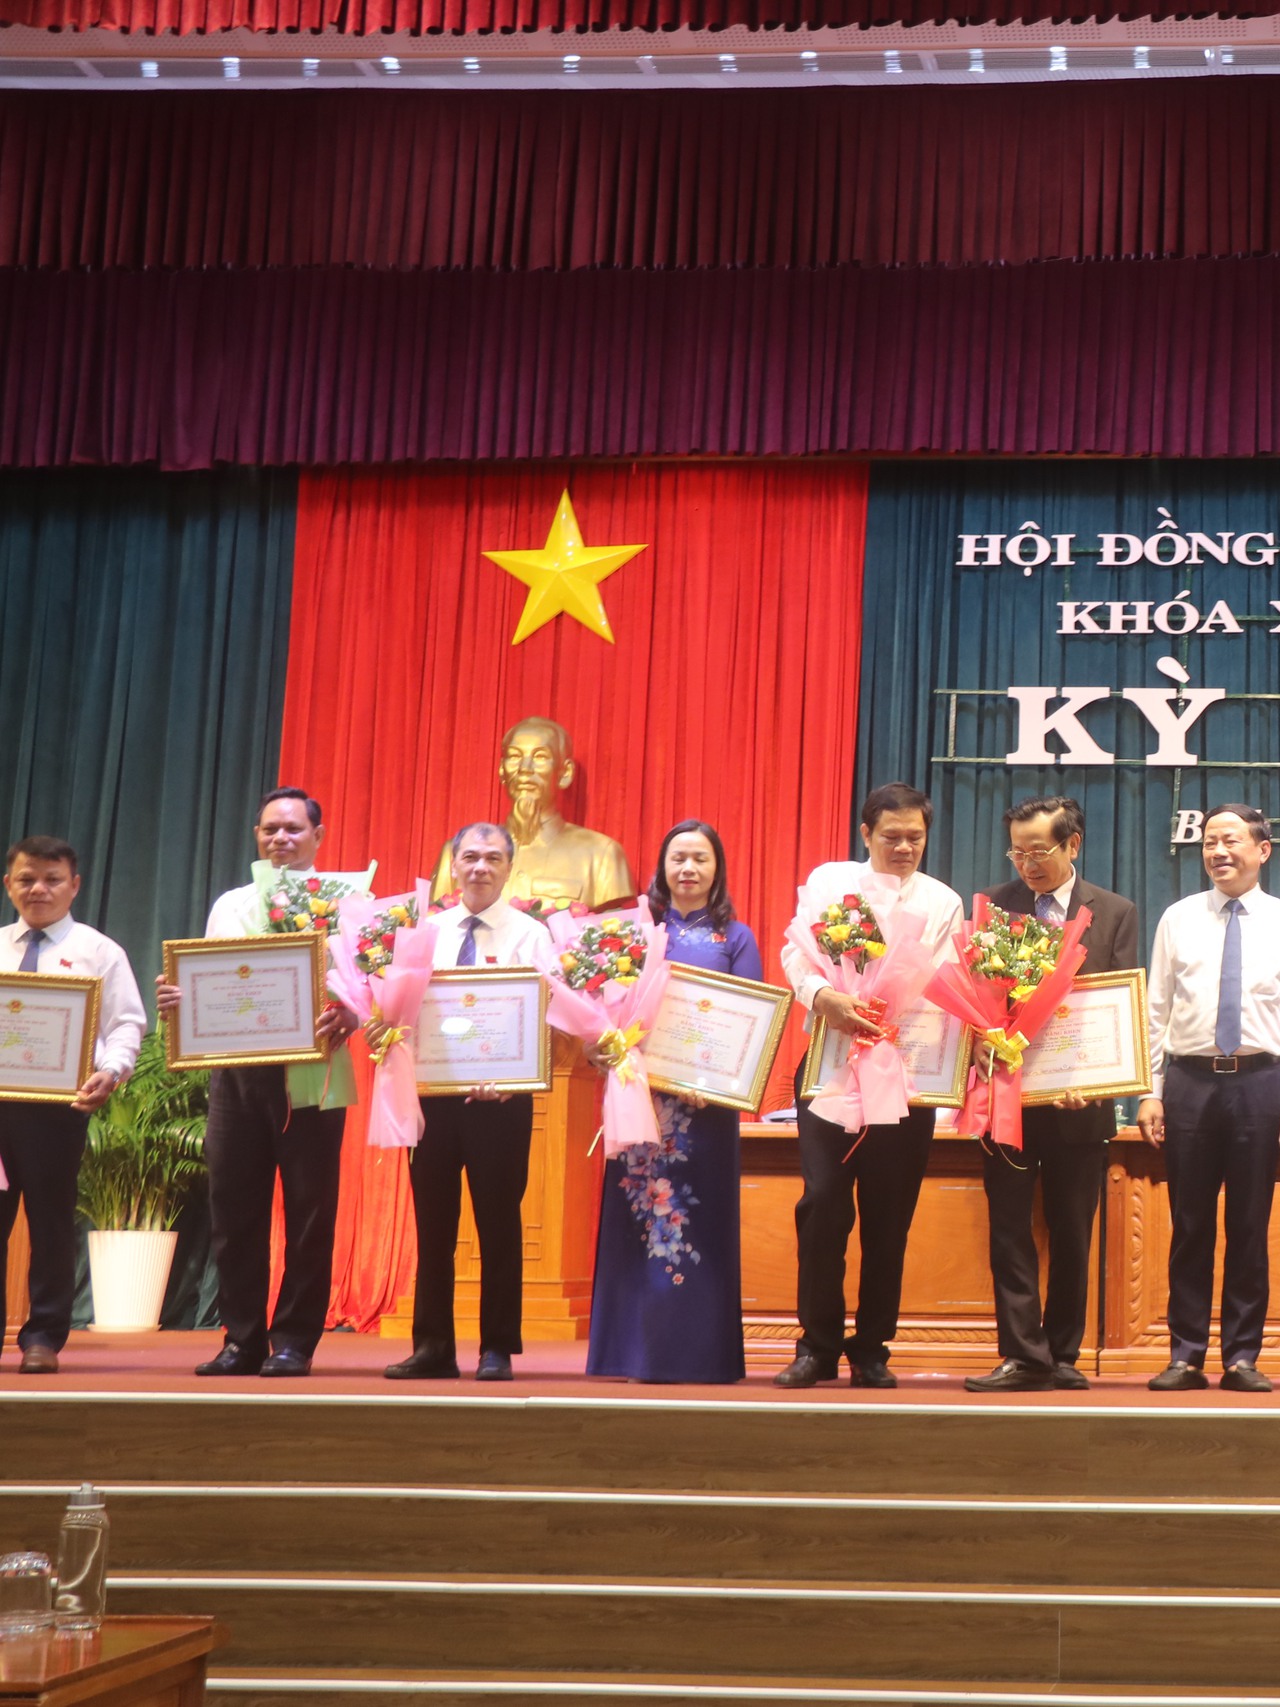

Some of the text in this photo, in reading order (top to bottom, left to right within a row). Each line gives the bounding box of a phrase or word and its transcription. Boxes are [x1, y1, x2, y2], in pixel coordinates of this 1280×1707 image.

[955, 521, 1076, 577] HỘI
[1096, 506, 1280, 567] ĐỒNG
[1056, 589, 1245, 634] KHÓA
[1006, 656, 1226, 766] KỲ
